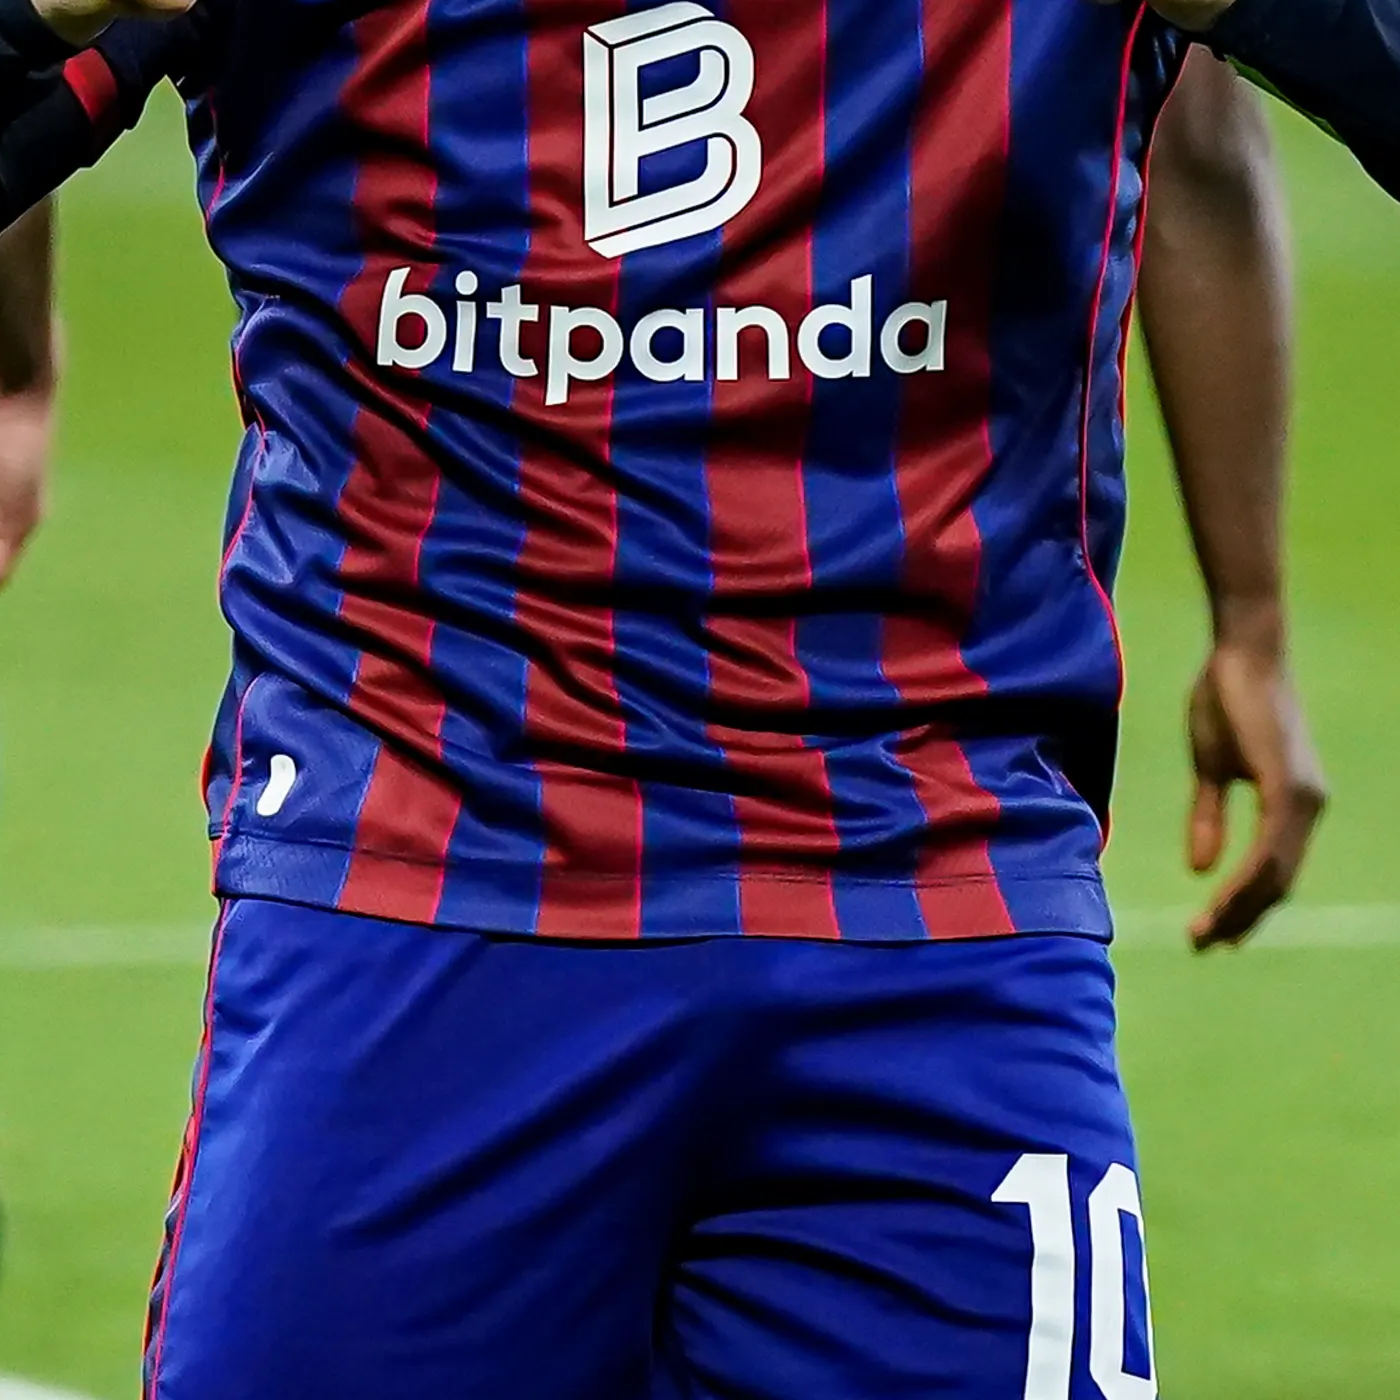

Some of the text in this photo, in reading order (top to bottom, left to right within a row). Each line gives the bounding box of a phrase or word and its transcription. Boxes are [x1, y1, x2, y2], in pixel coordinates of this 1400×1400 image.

[583, 0, 762, 259] B
[376, 267, 947, 406] bitpanda
[990, 1153, 1159, 1400] 10
